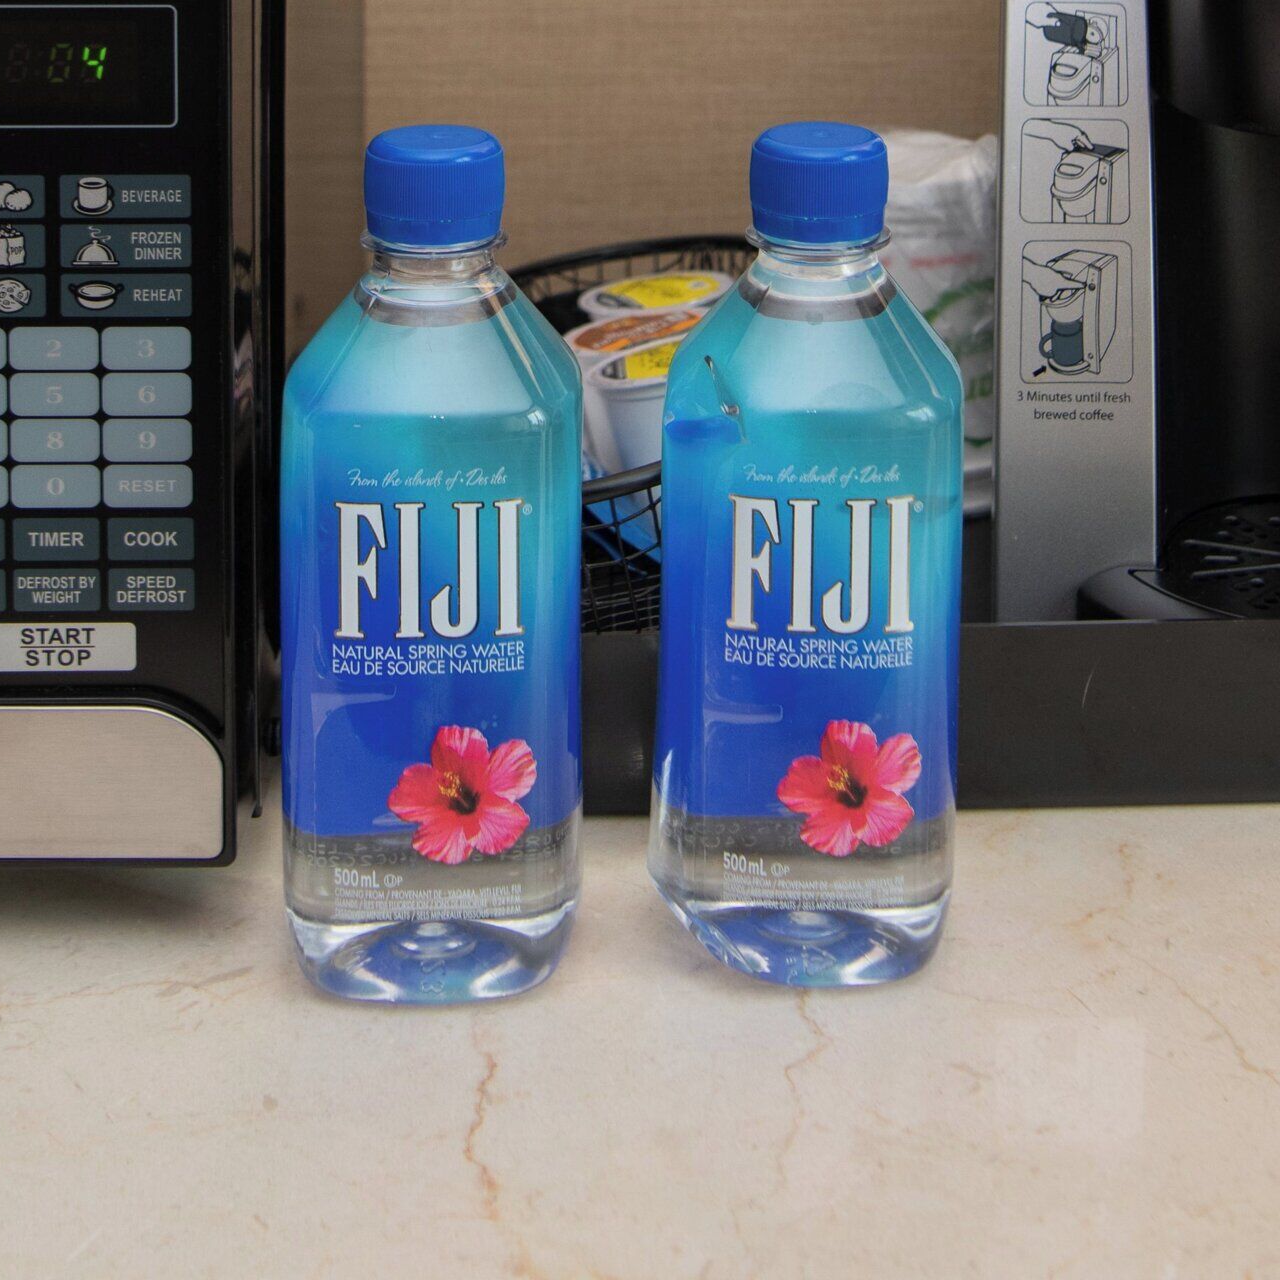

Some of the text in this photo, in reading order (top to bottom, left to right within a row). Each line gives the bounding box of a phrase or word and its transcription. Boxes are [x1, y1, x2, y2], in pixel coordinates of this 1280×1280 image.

[121, 190, 182, 203] BEVERAGE
[131, 232, 182, 245] FROZEN
[134, 248, 182, 261] DINNER
[132, 289, 182, 302] REHEAT
[46, 339, 62, 358] 2
[137, 339, 155, 358] 3
[46, 385, 63, 404] 5
[137, 385, 156, 404] 6
[1017, 391, 1131, 403] 3 Minutes until fresh
[1033, 408, 1114, 421] brewed coffee
[46, 431, 64, 449] 8
[138, 431, 156, 449] 9
[347, 468, 378, 487] From
[382, 468, 402, 488] the
[404, 469, 442, 488] islands
[445, 470, 461, 491] of
[466, 468, 488, 486] Des
[743, 463, 773, 482] From
[777, 464, 797, 484] the
[799, 464, 838, 485] islands
[839, 467, 856, 488] of
[860, 464, 882, 484] Des
[46, 477, 65, 496] 0
[119, 479, 177, 493] RESET
[28, 532, 84, 547] TIMER
[123, 531, 178, 547] COOK
[333, 498, 526, 640] FIJI
[725, 493, 916, 634] FIJI
[17, 576, 96, 589] DEFROST BY
[126, 576, 176, 588] SPEED
[32, 590, 81, 604] WEIGHT
[116, 590, 186, 603] DEFROST
[20, 628, 95, 645] START
[724, 632, 913, 655] NATURAL SPRING WATER
[25, 649, 91, 666] STOP
[332, 641, 525, 660] NATURAL SPRING WATER
[724, 648, 913, 670] EAU DE SOURCE NATURELLE
[332, 655, 525, 676] EAU DE SOURCE NATURELLE
